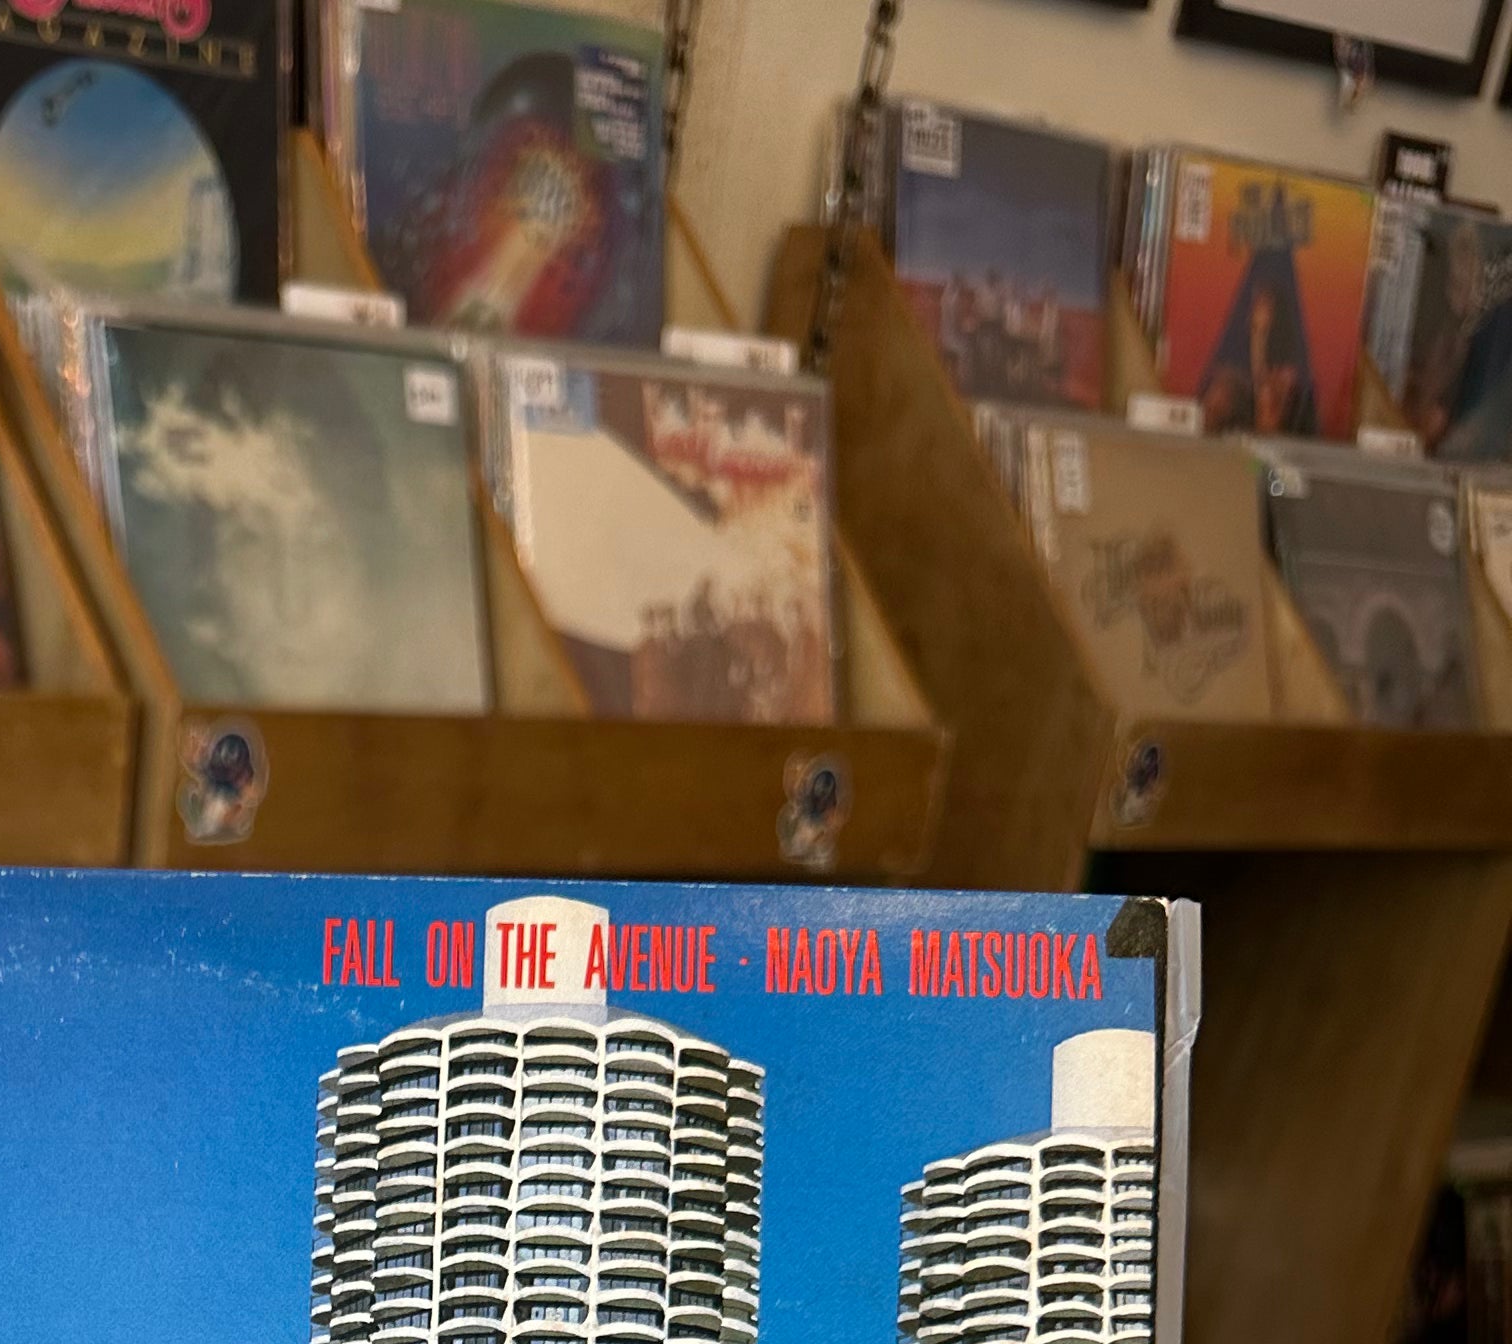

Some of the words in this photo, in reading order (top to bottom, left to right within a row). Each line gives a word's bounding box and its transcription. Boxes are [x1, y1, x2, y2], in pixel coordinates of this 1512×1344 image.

[322, 917, 400, 989] FALL
[426, 921, 473, 988] ON
[496, 921, 556, 990] THE
[584, 925, 716, 995] AVENUE
[766, 928, 883, 996] NAOYA
[909, 929, 1104, 1001] MATSUOKA
